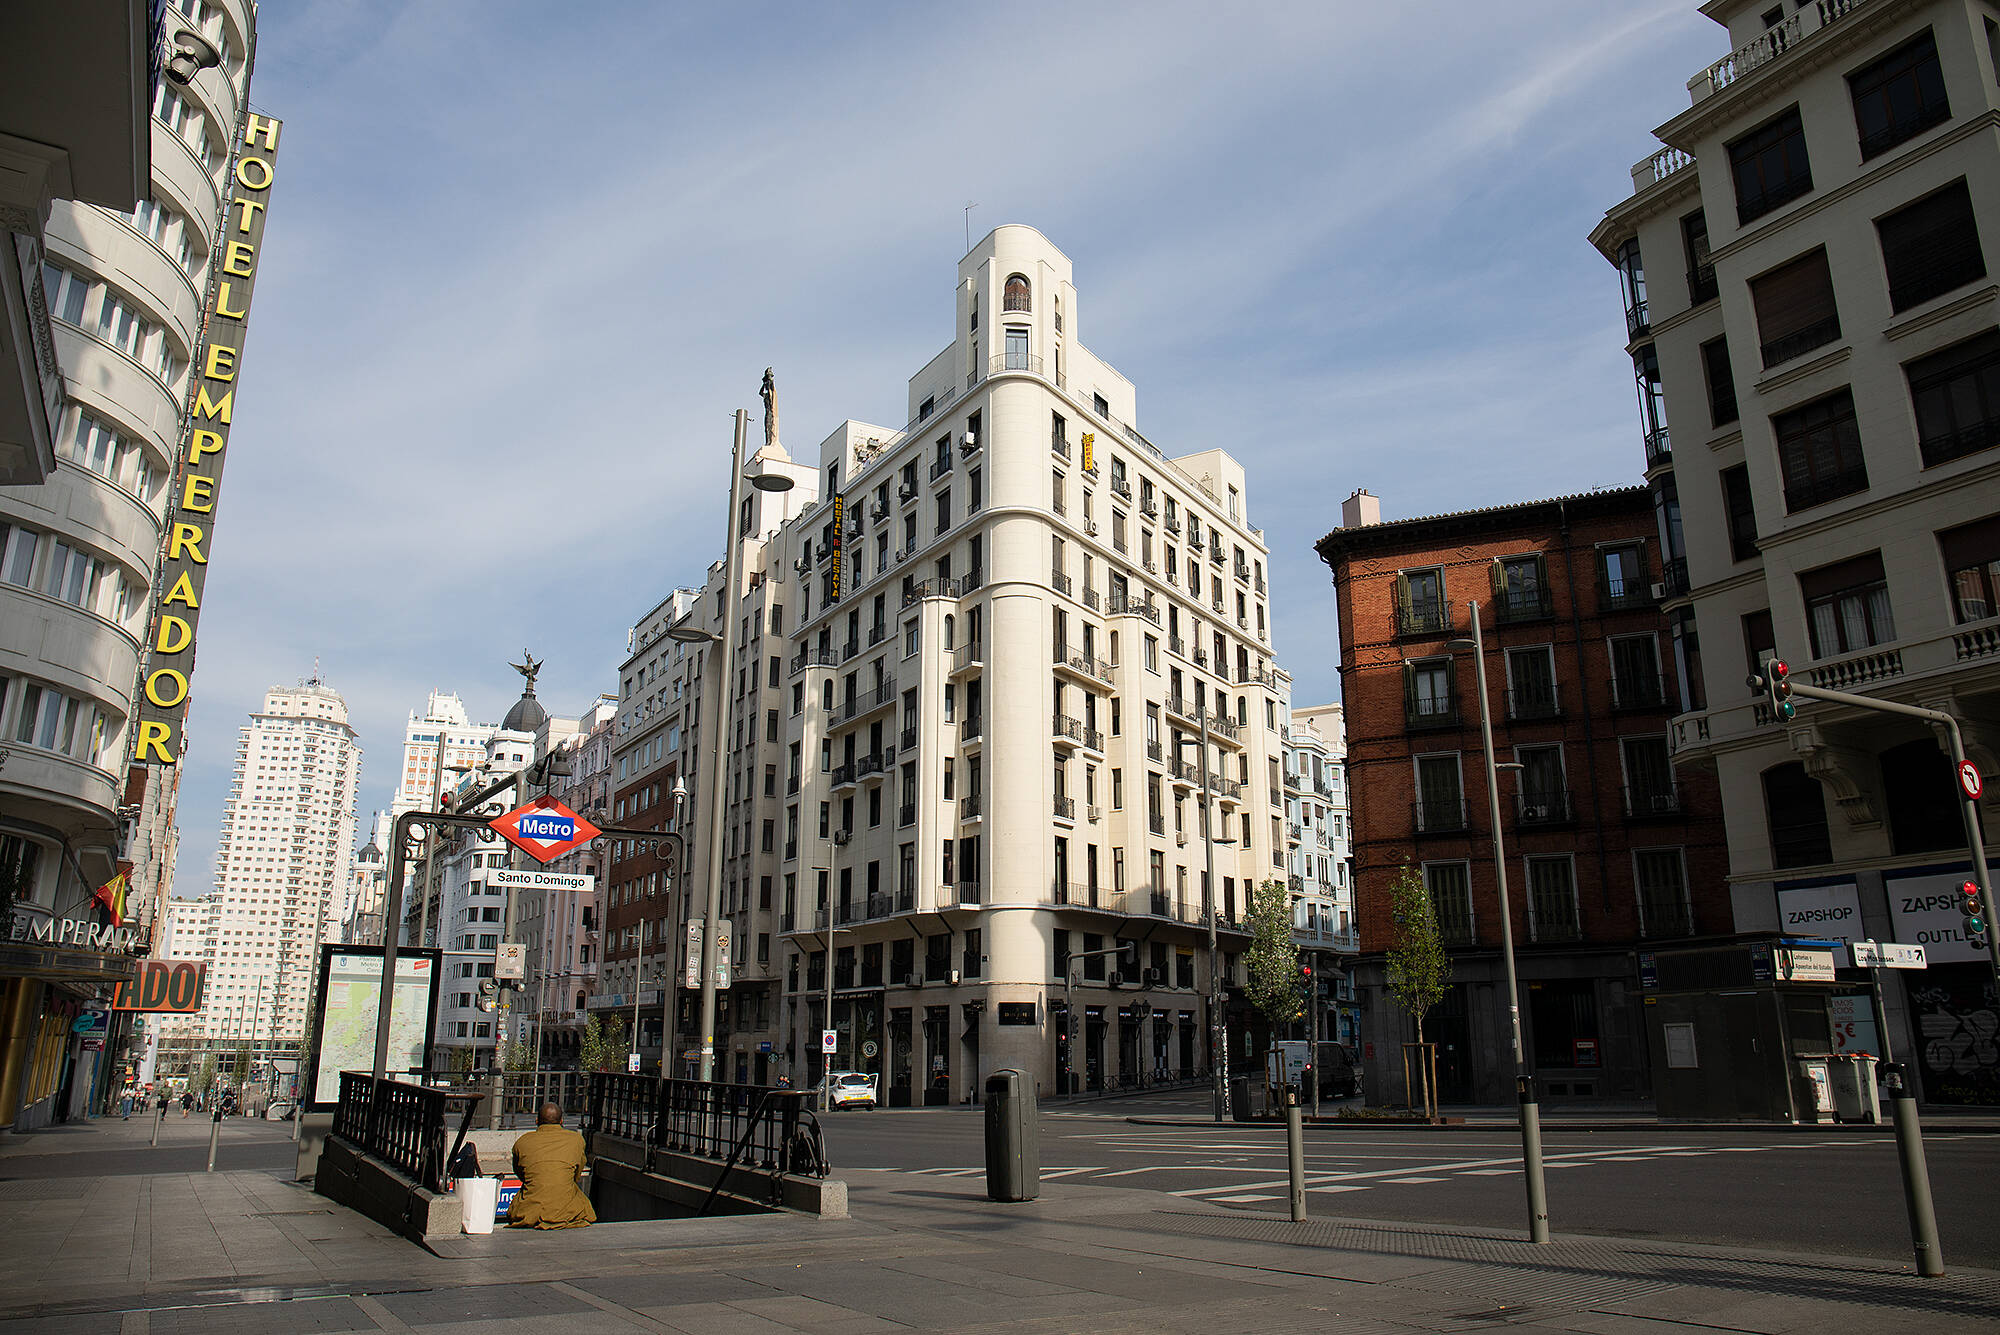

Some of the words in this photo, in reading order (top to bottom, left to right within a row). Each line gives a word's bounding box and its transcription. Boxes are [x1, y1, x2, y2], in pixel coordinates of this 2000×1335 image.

[215, 113, 279, 320] HOTEL
[834, 496, 843, 536] HOSTAL
[134, 343, 237, 763] EMPERADOR
[832, 549, 841, 598] BESAYA
[522, 819, 572, 837] Metro
[497, 872, 531, 883] Santo
[534, 875, 585, 889] Domingo
[1788, 907, 1853, 924] ZAPSHOP
[1902, 894, 1963, 913] ZAPSH
